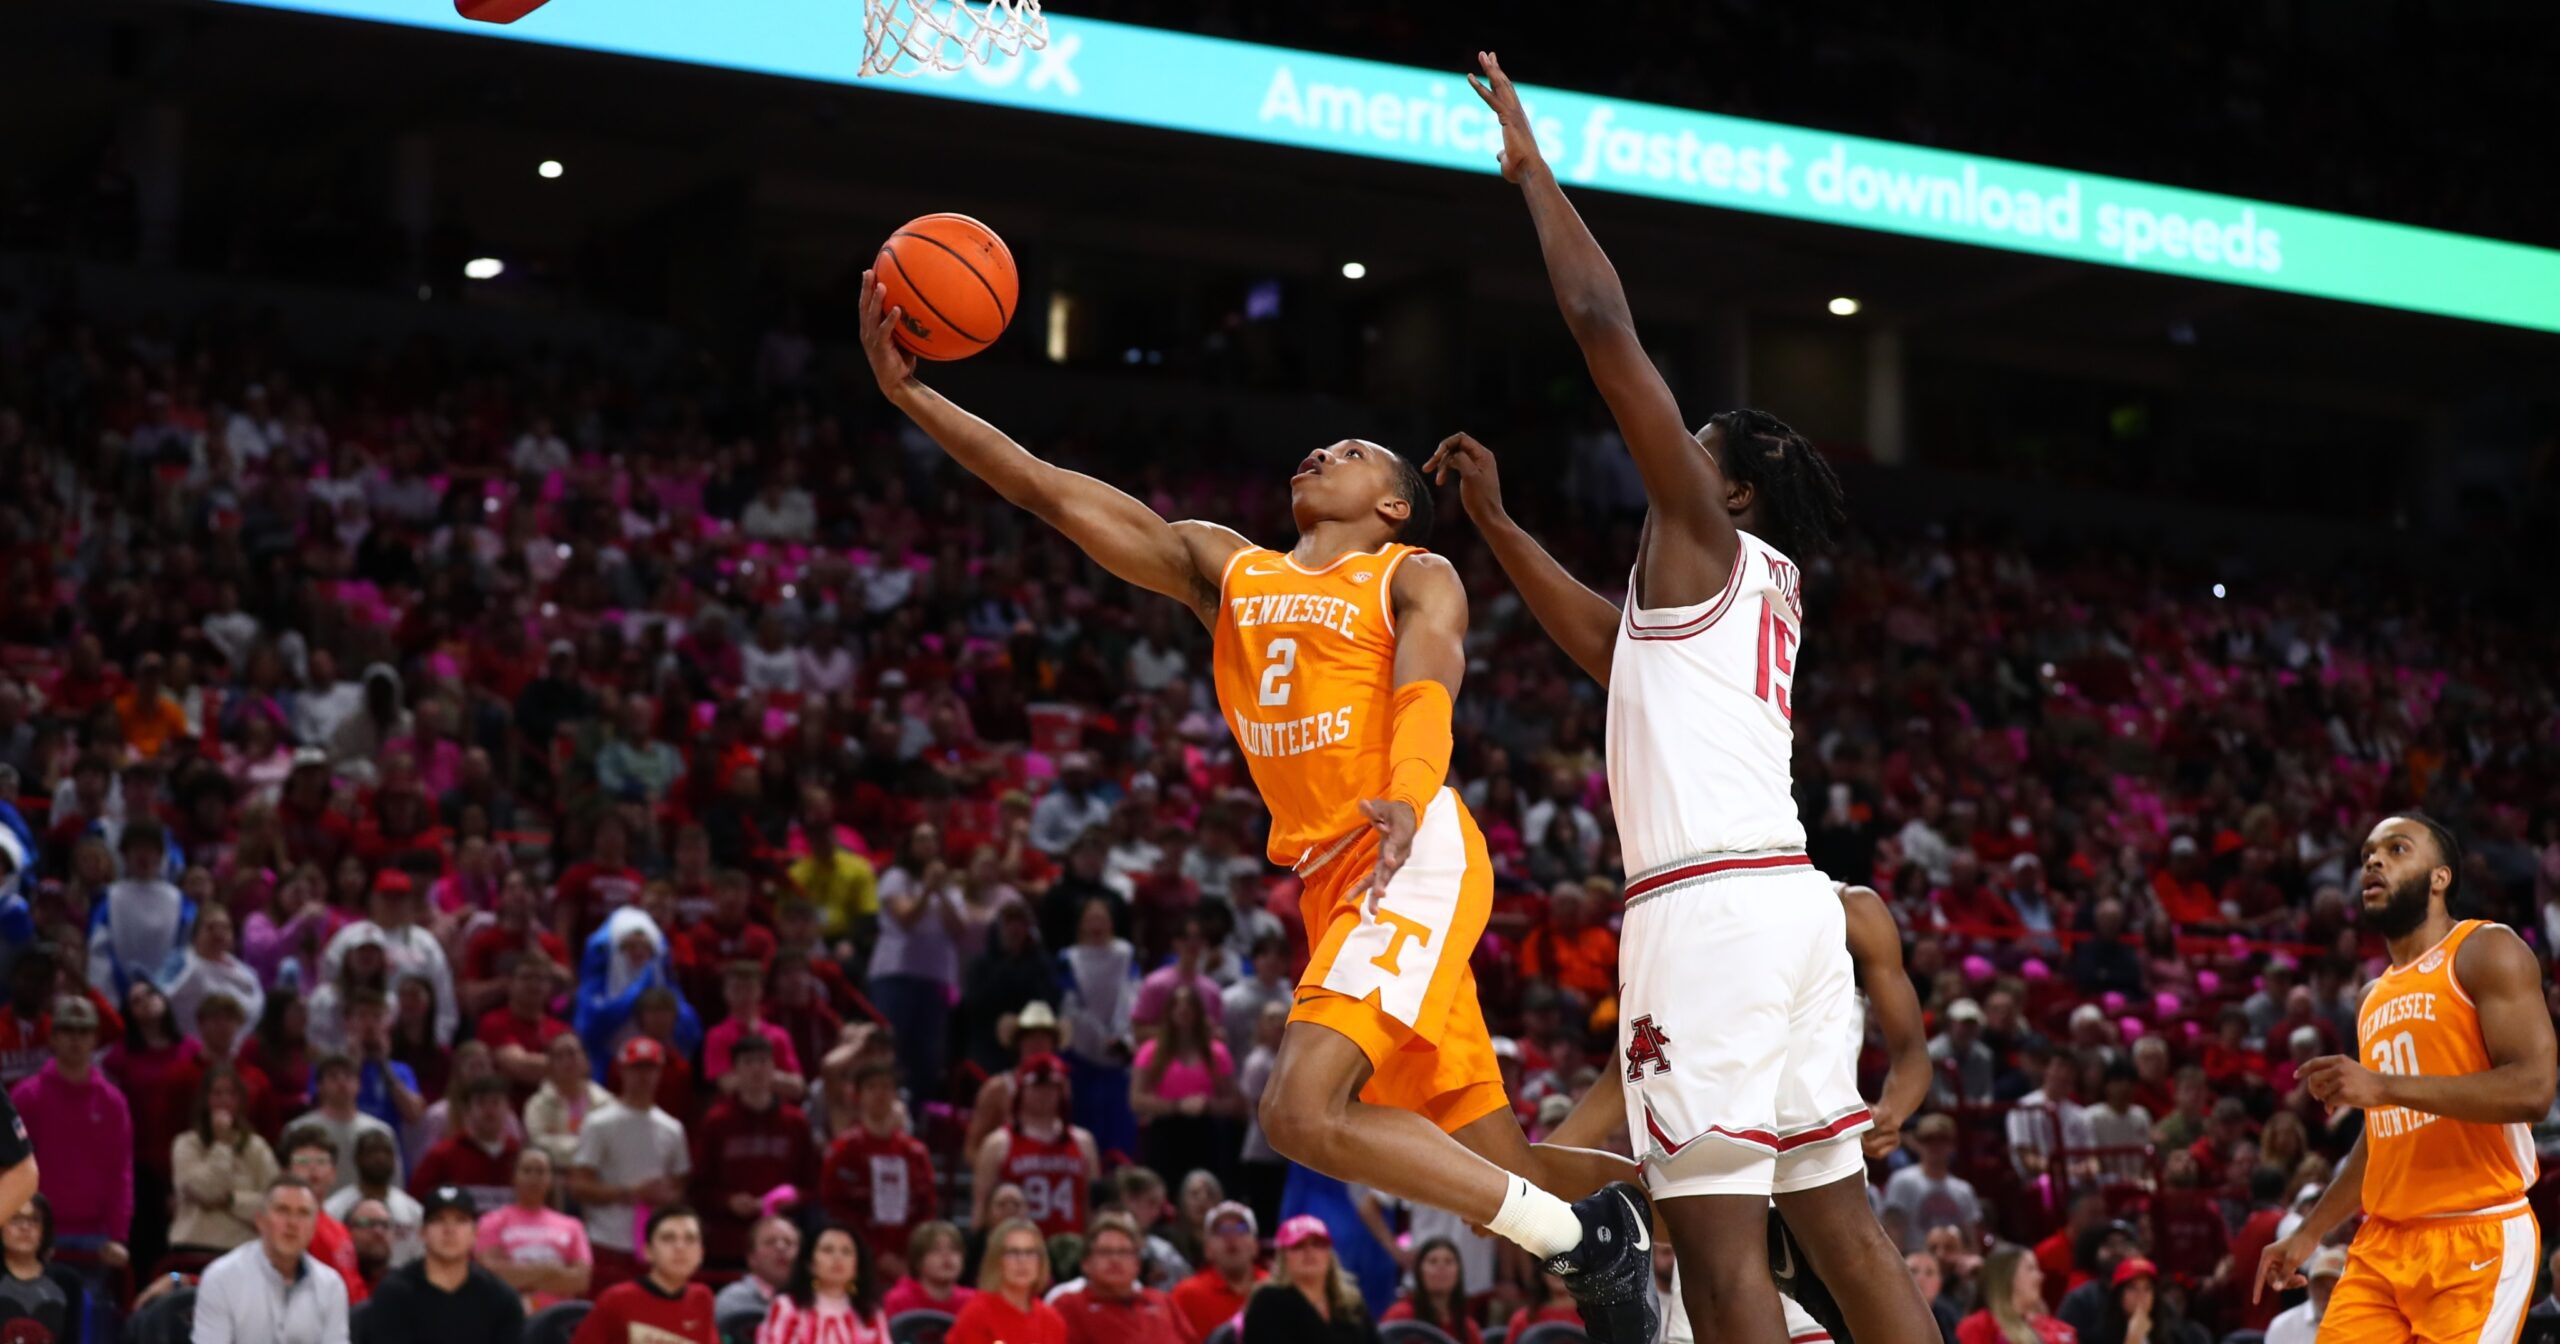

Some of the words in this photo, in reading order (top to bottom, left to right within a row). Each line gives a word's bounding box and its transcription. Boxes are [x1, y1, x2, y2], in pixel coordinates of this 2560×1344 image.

[1258, 64, 1564, 163] Americ's
[1571, 104, 1793, 199] fastest
[1804, 143, 2083, 244] download
[2096, 203, 2284, 274] speeds
[1230, 593, 1361, 641] TENNESSEE
[1258, 637, 1298, 707] 2
[1754, 595, 1797, 722] 15
[1362, 907, 1433, 978] T
[2361, 991, 2437, 1050] TENNESSEE
[1023, 1177, 1074, 1222] 94
